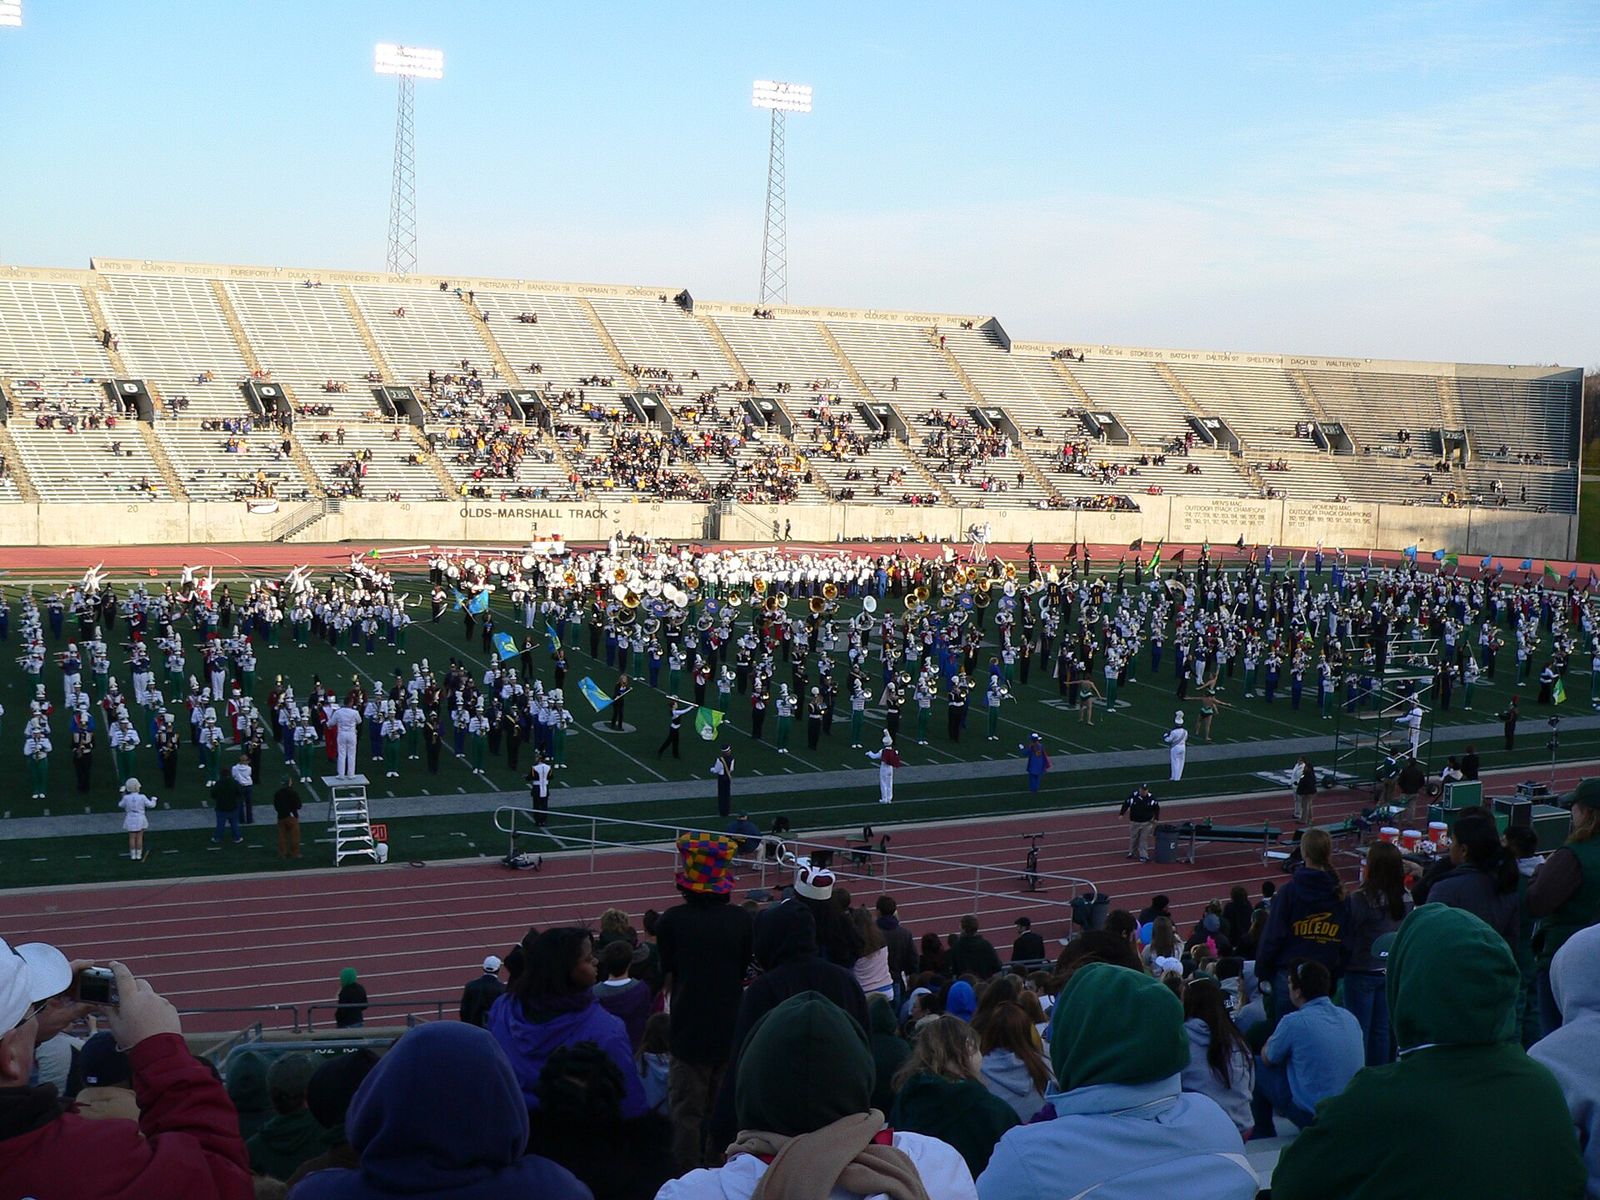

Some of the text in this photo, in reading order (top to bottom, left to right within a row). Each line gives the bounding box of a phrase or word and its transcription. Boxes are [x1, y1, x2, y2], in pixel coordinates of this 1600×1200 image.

[127, 504, 138, 513] 20
[460, 508, 608, 518] OLDS-MARSHALL TRACK
[1293, 920, 1340, 937] TOLEDO
